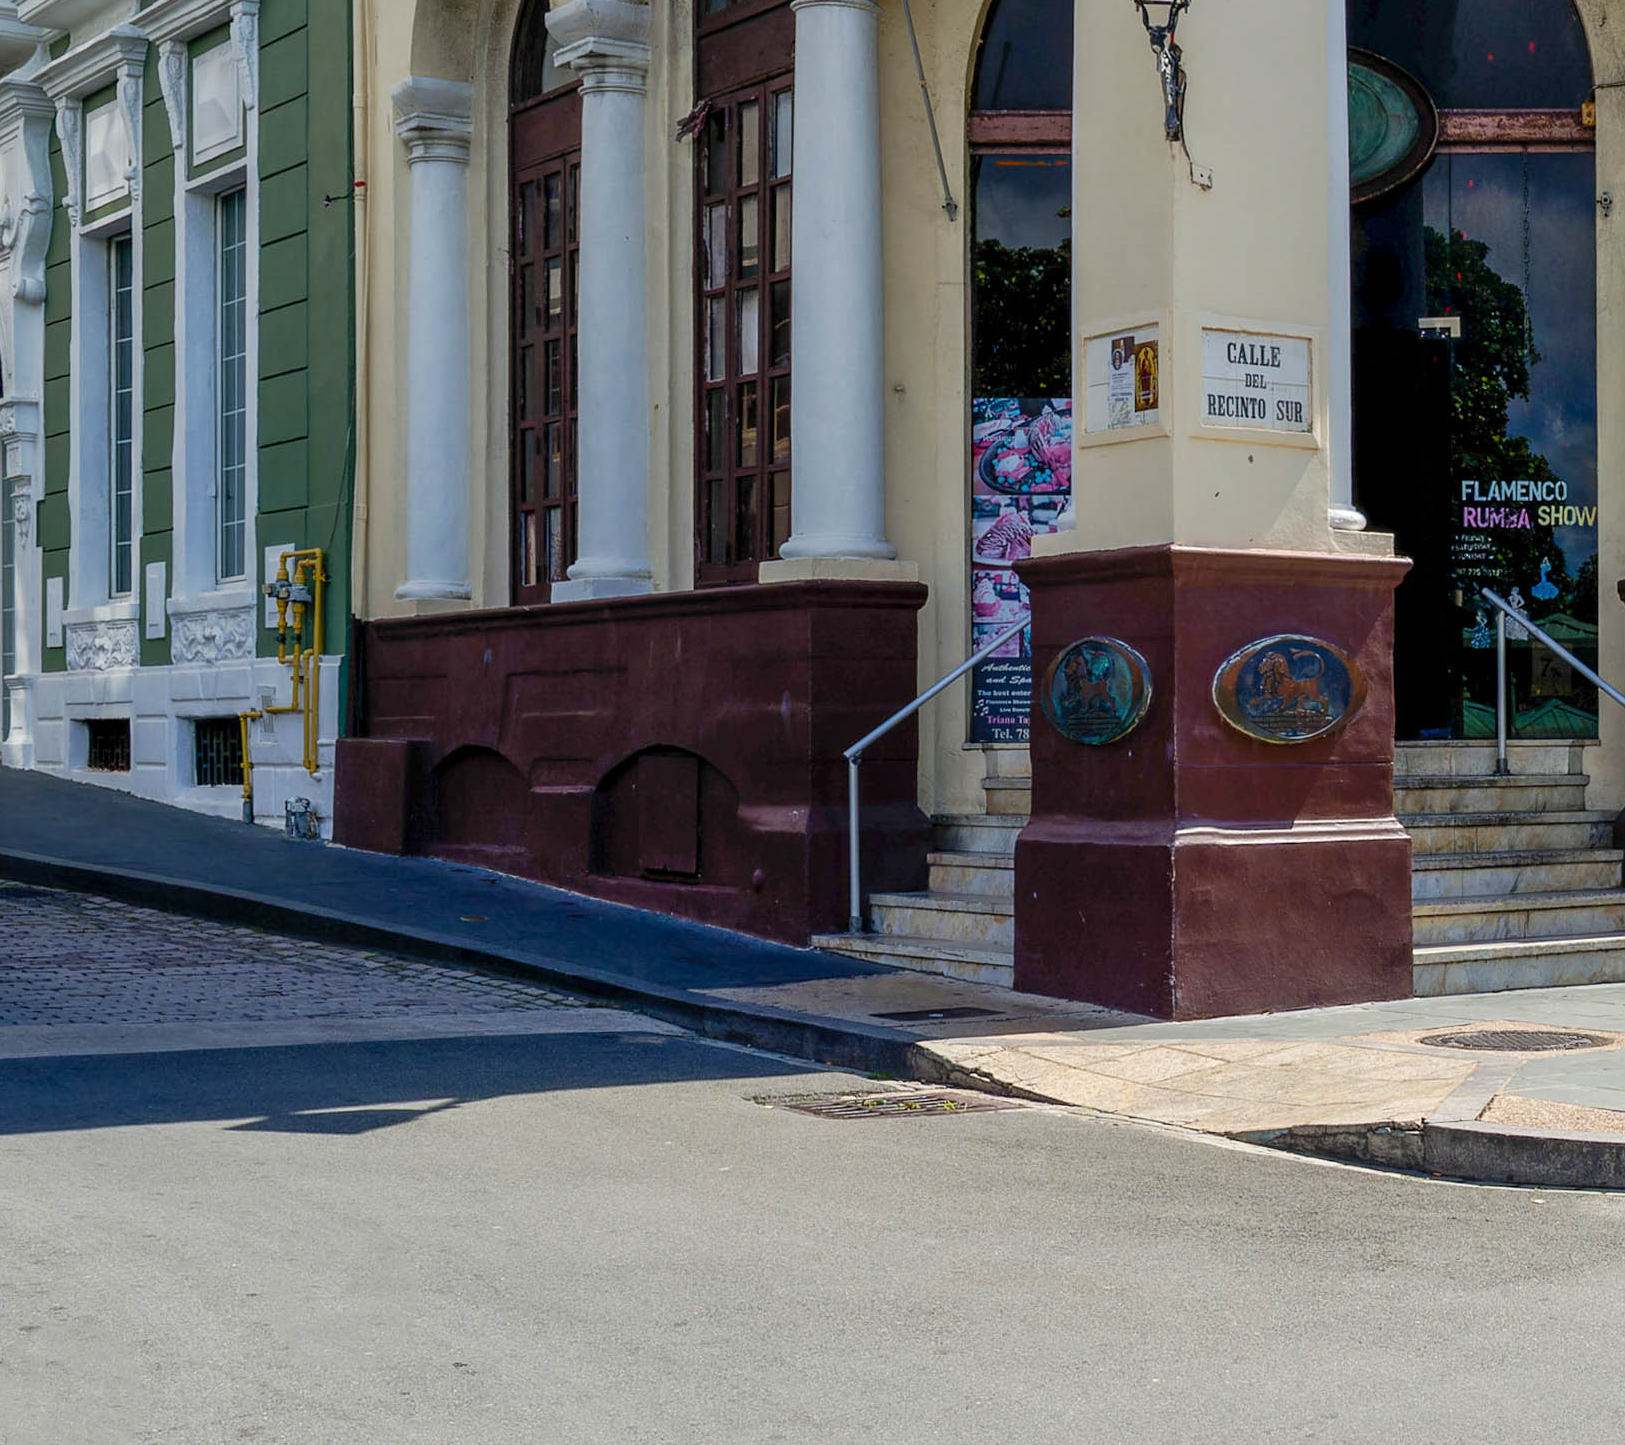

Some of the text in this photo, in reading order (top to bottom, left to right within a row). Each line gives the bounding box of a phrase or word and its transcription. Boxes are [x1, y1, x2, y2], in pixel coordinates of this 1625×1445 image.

[1227, 342, 1281, 368] CALLE
[1245, 373, 1267, 389] DEL
[1207, 394, 1303, 423] RECINTO SUR
[1462, 480, 1568, 501] FLAMENCO
[1463, 505, 1597, 529] RUMBA SHOW
[986, 676, 1007, 684] and
[987, 716, 1015, 724] Triana
[992, 728, 1030, 739] Tel. 78
